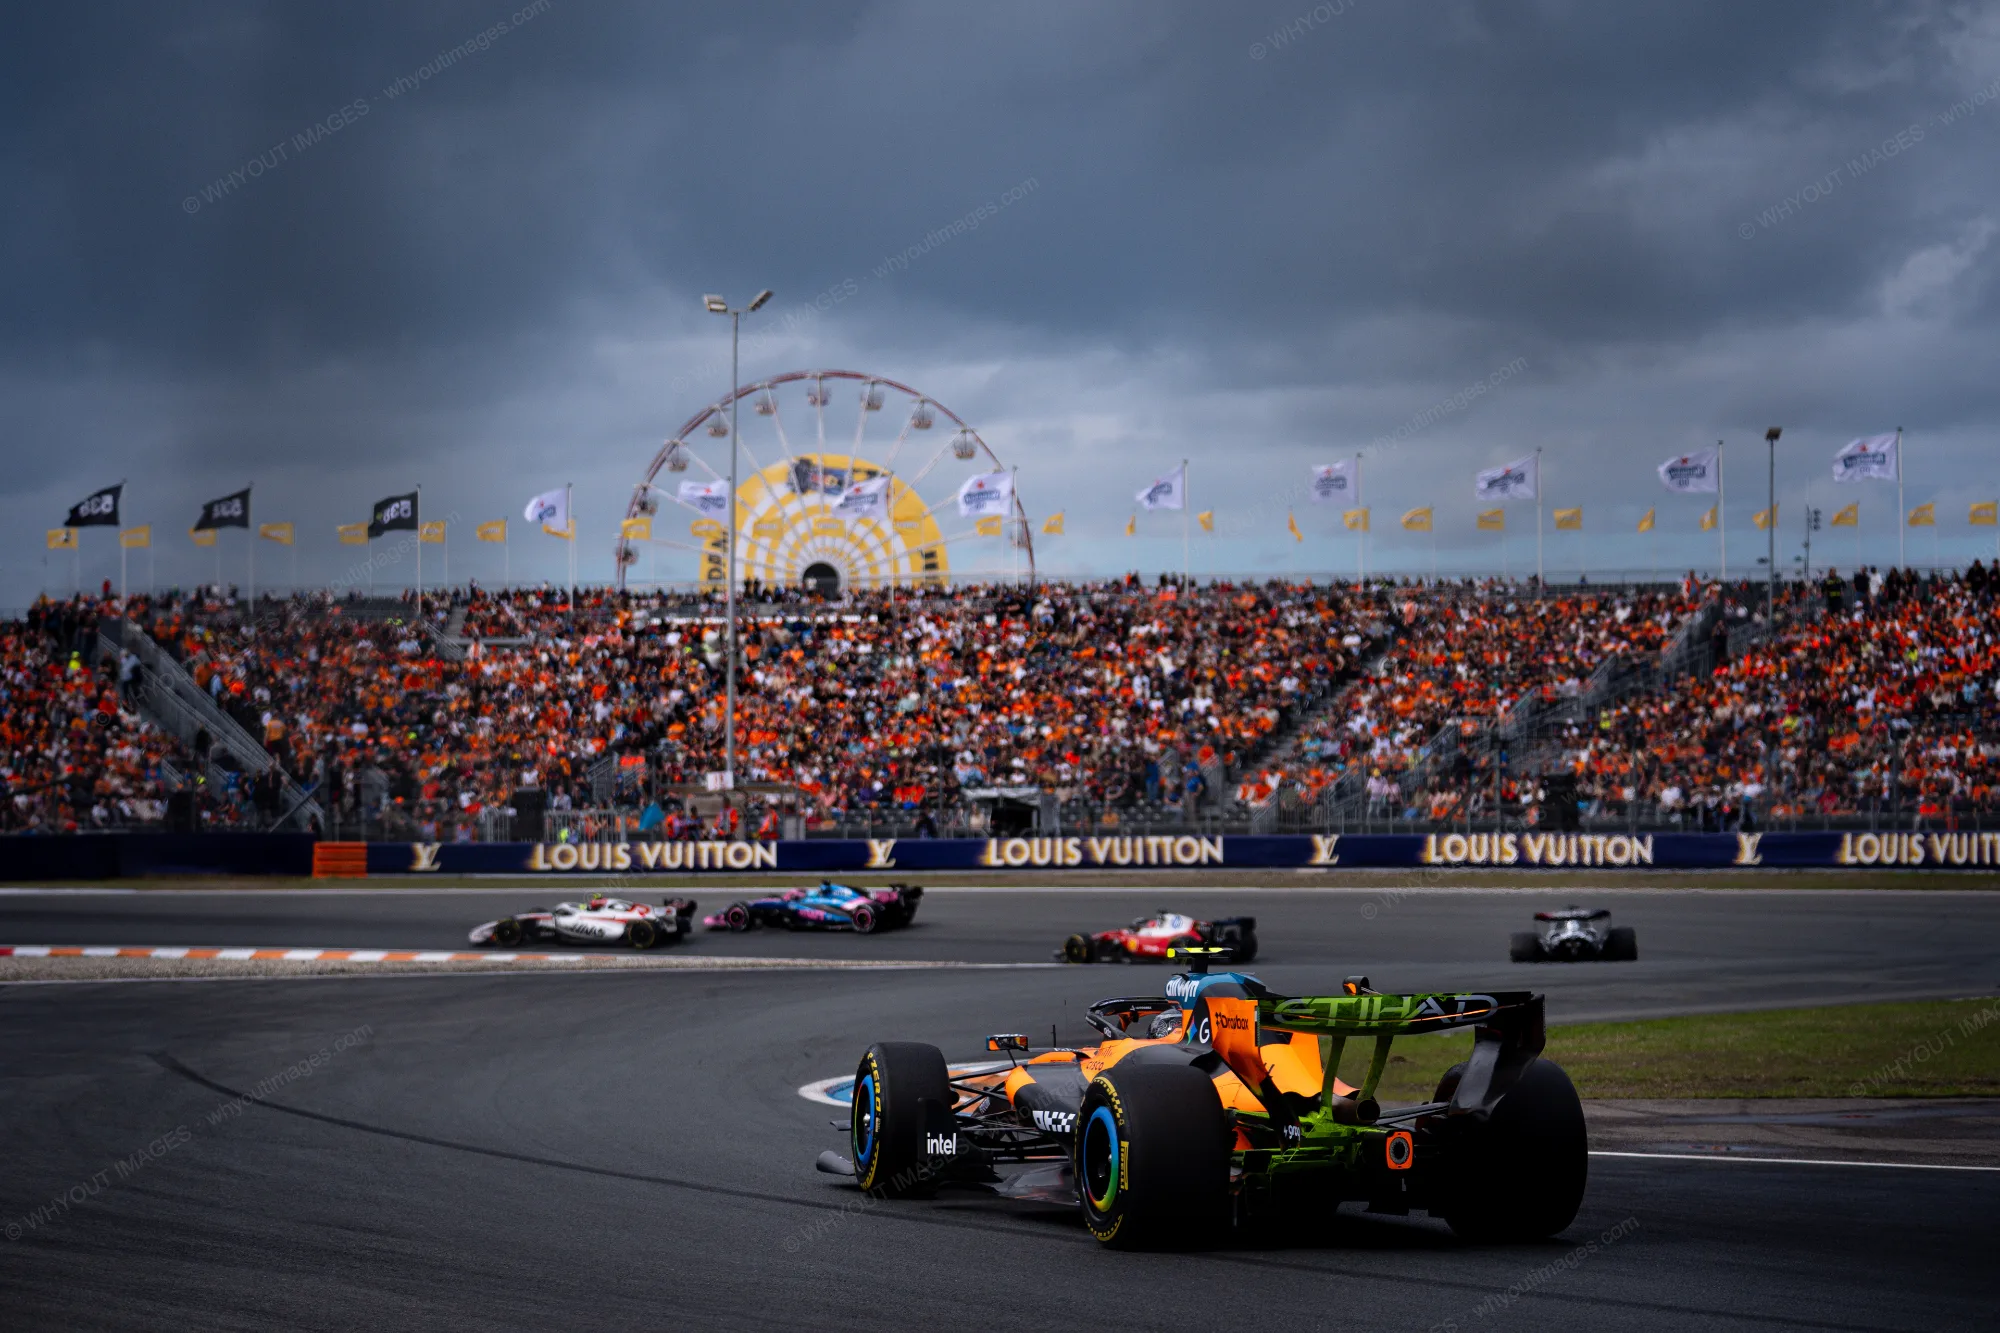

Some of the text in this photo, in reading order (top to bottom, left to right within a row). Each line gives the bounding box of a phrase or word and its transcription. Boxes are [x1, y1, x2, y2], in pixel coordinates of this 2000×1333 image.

[535, 842, 632, 870] LOUIS
[640, 841, 778, 870] VUITTON
[986, 835, 1224, 866] LOUIS VUITTON
[1426, 832, 1654, 865] LOUIS VUITTON
[1841, 832, 1926, 865] LOUIS
[1221, 1014, 1249, 1031] Dropbox
[1273, 994, 1499, 1026] ETIHAD
[870, 1059, 882, 1112] ZERO
[926, 1132, 957, 1155] intel
